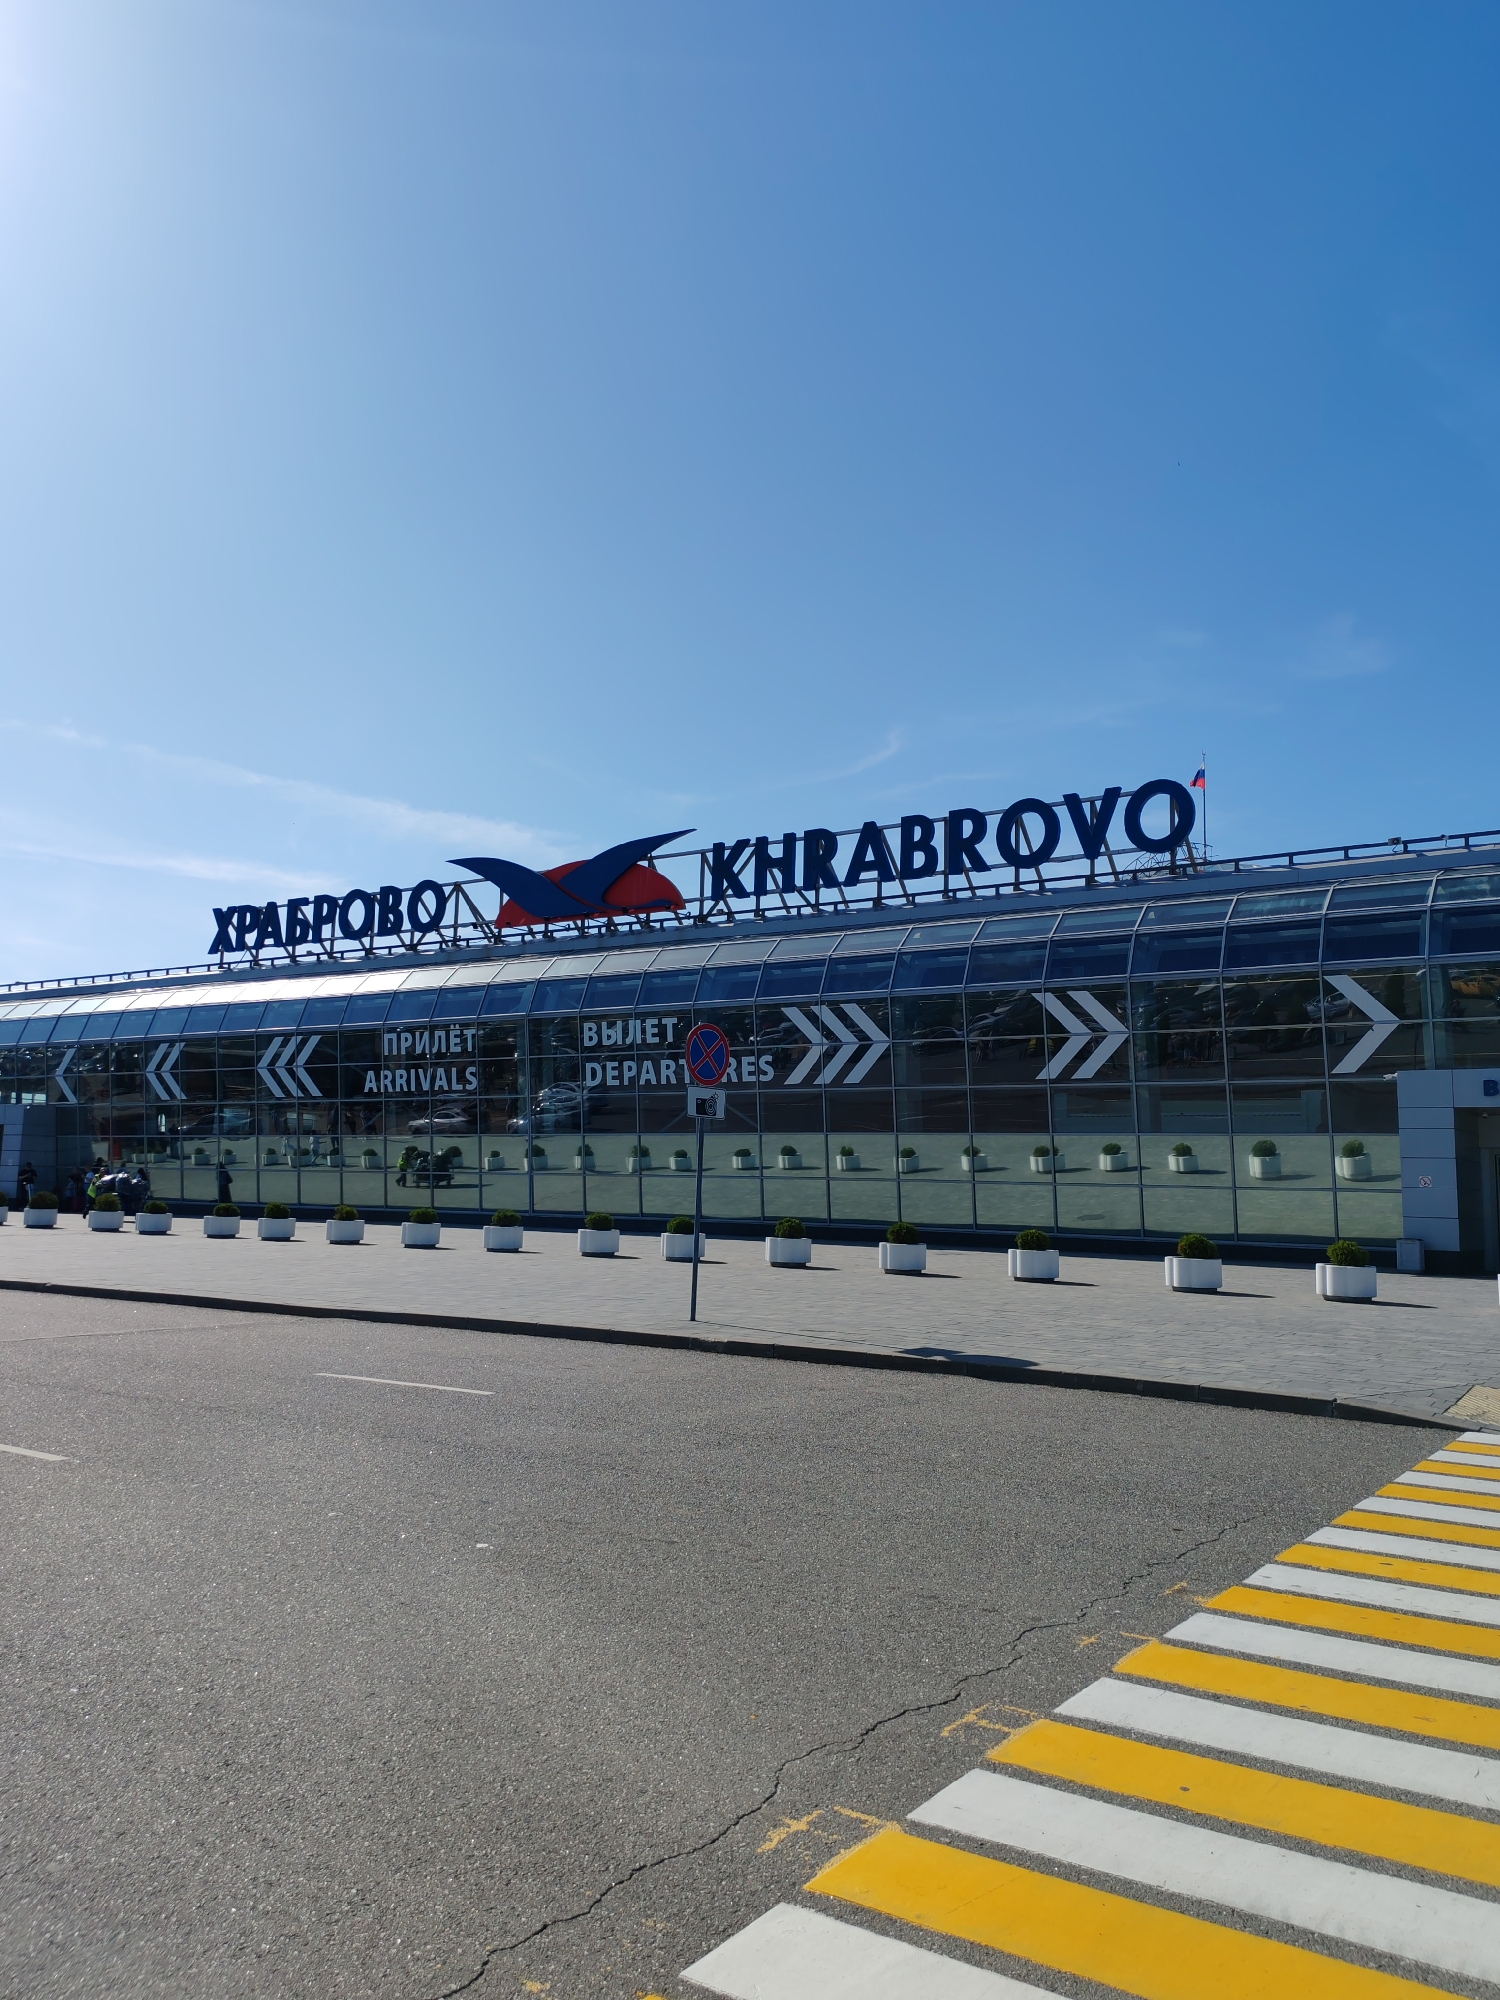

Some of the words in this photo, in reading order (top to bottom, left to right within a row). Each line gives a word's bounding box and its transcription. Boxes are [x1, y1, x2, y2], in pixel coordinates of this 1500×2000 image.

[710, 778, 1196, 901] KHRABROVO
[207, 879, 447, 955] ХРАБРОВО
[383, 1023, 477, 1056] ПРИЛЁТ
[583, 1019, 678, 1048] ВЫЛЕТ
[363, 1066, 478, 1093] ARRIVALS
[586, 1055, 775, 1087] DEPARTRES
